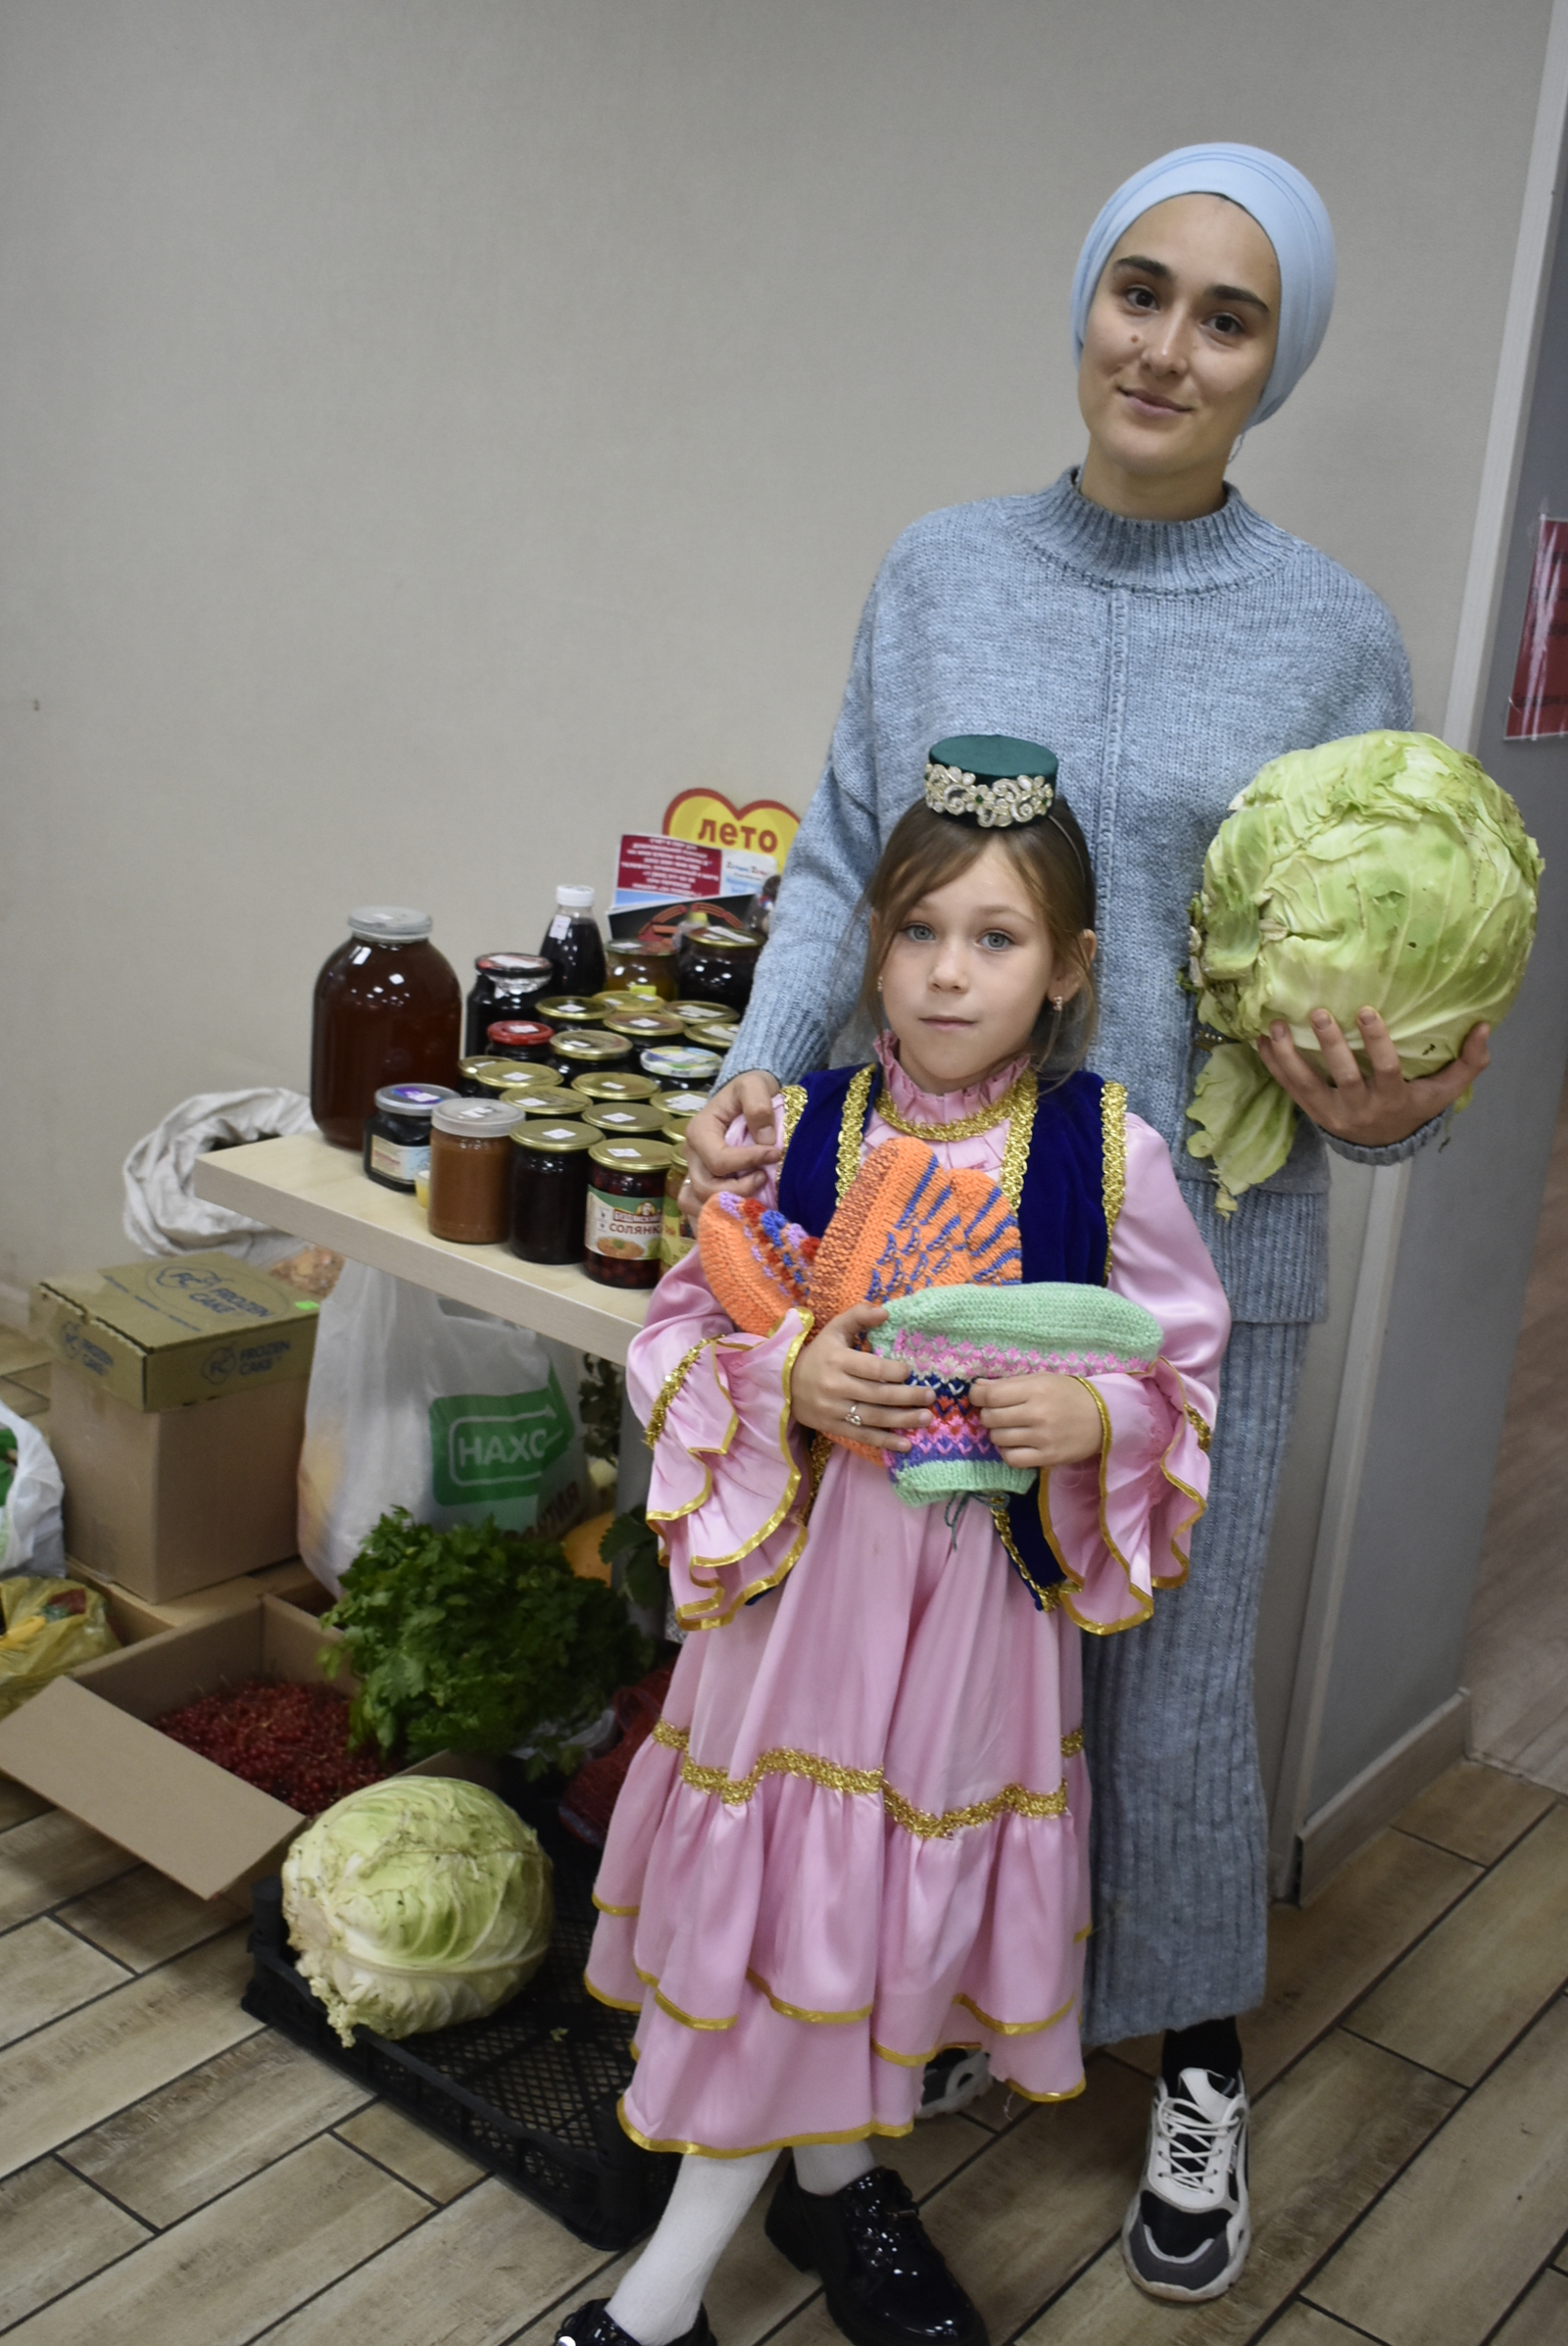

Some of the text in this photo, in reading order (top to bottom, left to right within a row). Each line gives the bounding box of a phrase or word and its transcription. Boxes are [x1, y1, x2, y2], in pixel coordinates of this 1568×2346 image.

[698, 818, 778, 854] лето
[610, 1223, 662, 1235] СОЛЯНК
[188, 1293, 236, 1314] CAKE
[239, 1340, 291, 1361] FROZEN
[239, 1357, 273, 1376] CAKE
